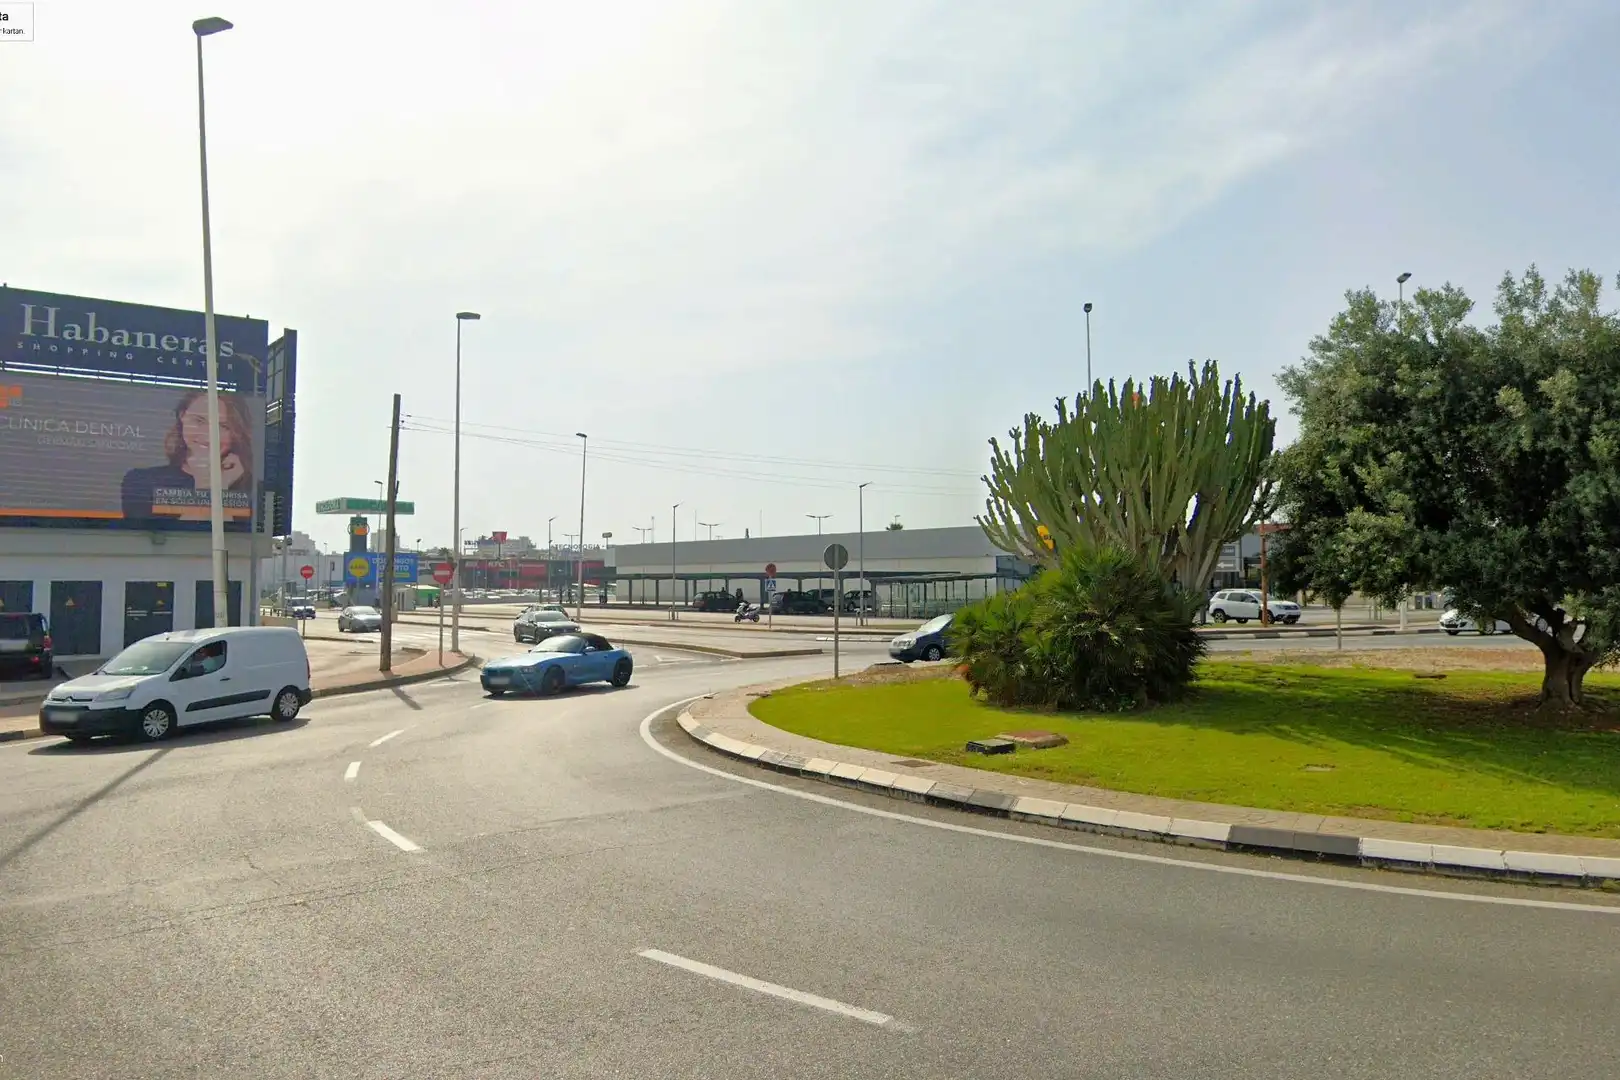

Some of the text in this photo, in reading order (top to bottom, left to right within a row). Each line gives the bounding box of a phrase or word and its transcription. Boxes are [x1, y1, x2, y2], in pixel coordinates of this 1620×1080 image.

[17, 341, 233, 370] SHOPPING CENTR
[75, 420, 146, 438] DENTAL
[554, 543, 600, 551] TECNOOGIA
